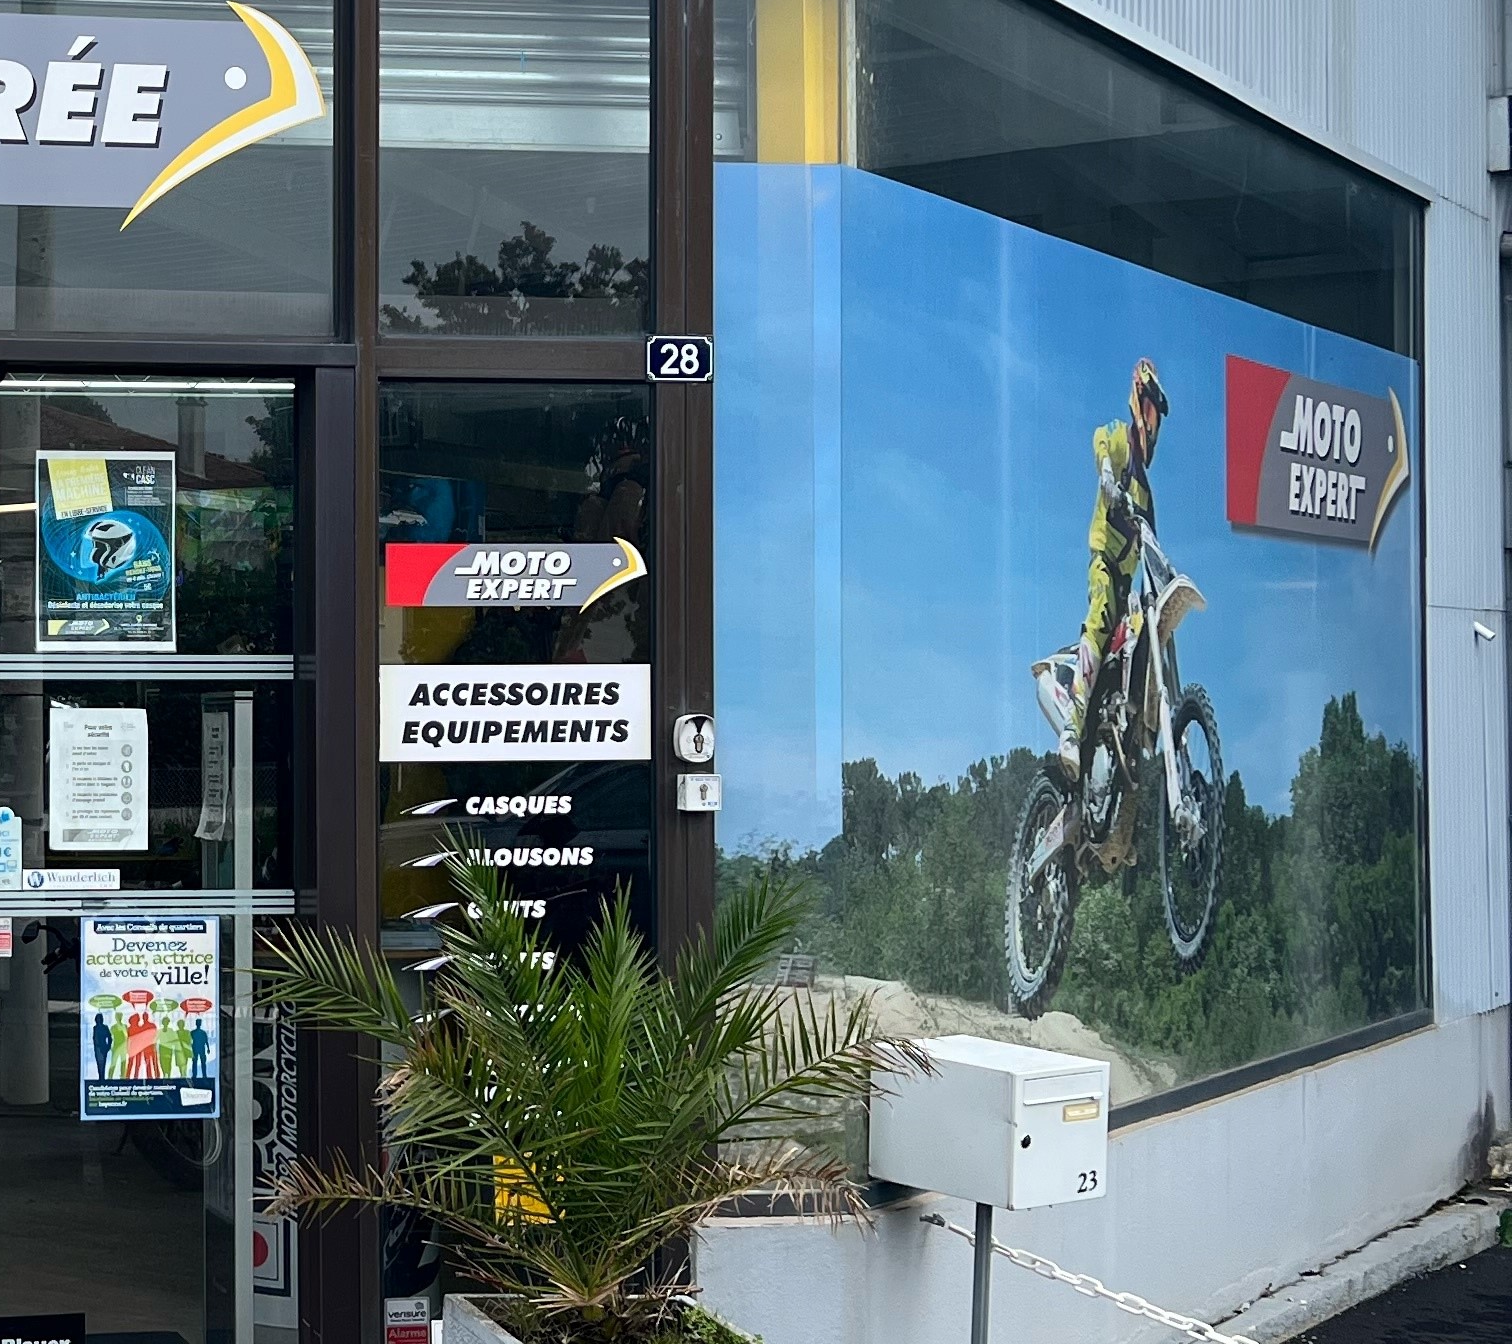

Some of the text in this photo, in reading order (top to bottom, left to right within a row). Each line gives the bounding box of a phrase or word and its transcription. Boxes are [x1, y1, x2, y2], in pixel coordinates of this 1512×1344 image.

[660, 343, 700, 374] 28
[1279, 394, 1363, 466] MOTO
[1289, 462, 1366, 524] EXPERT
[455, 550, 572, 577] MOTO
[466, 577, 577, 601] EXPERT
[408, 682, 621, 706] ACCESSOIRES
[401, 719, 630, 746] EQUIPEMENTS
[465, 795, 573, 818] CASQUES
[46, 871, 116, 883] Wunderlich
[96, 923, 204, 933] Avec les Conseils de quartiers
[111, 937, 188, 952] Devenez
[86, 949, 214, 968] acteur, actrice
[99, 964, 210, 986] de votre ville!
[280, 1015, 298, 1148] MOTORCYCLE
[1077, 1170, 1098, 1194] 23
[388, 1310, 427, 1319] verisure
[388, 1328, 427, 1339] Alarme
